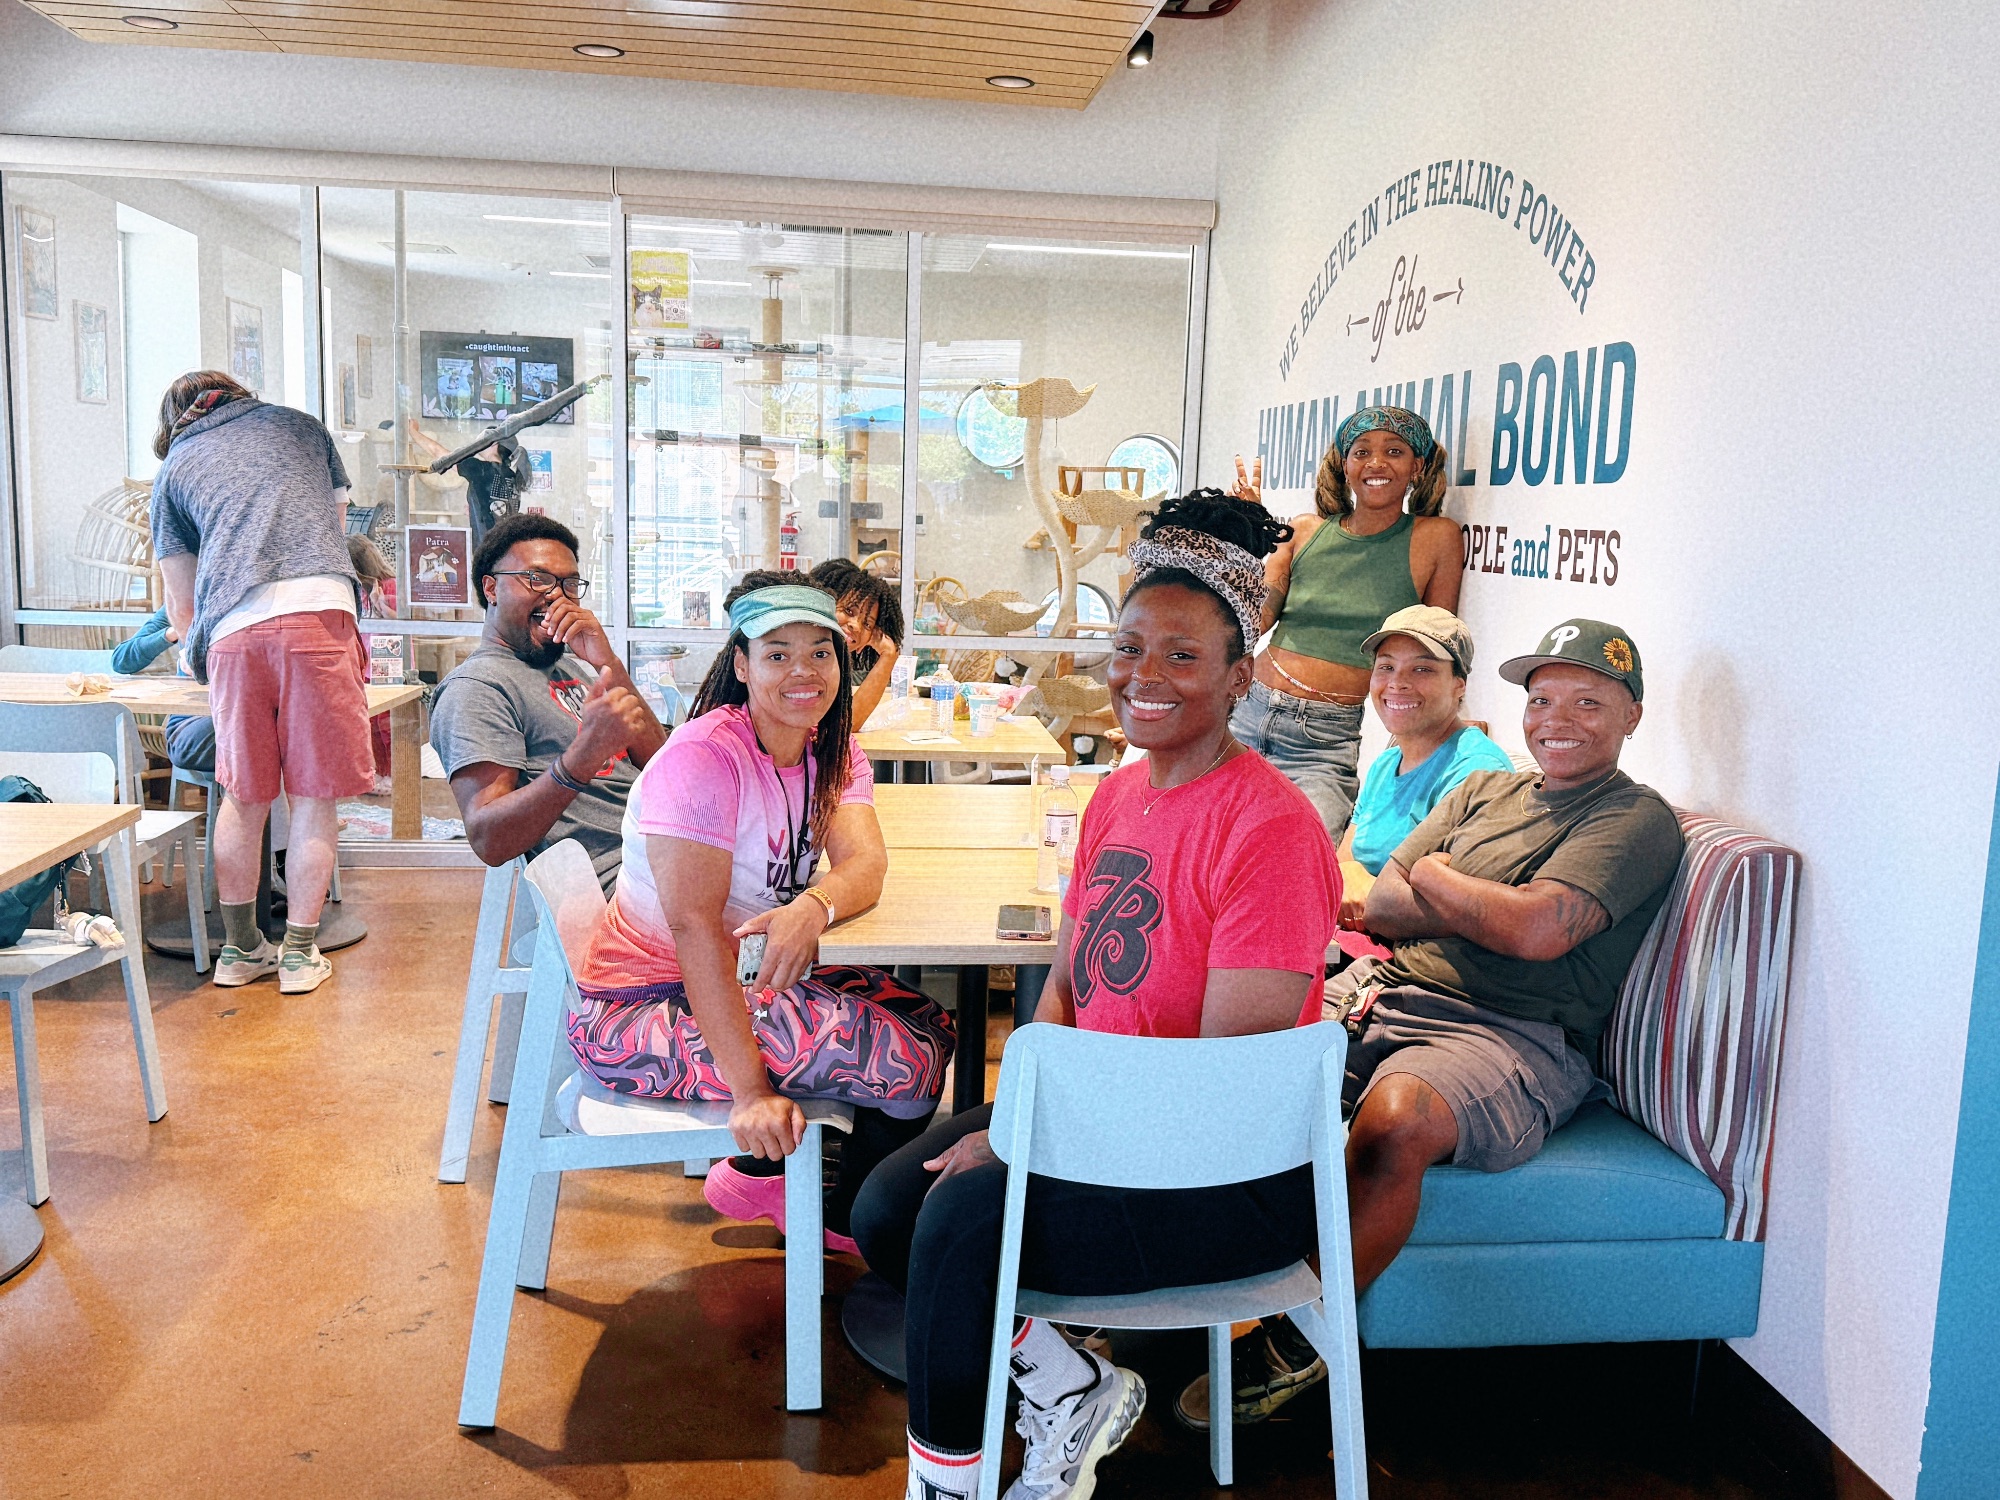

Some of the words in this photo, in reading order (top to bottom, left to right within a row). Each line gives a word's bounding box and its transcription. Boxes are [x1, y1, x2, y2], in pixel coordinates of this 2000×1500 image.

[1279, 323, 1299, 383] WE
[1300, 220, 1357, 338] BELIEVE
[1361, 196, 1380, 248] IN
[1385, 168, 1421, 227] THE
[1424, 158, 1514, 220] HEALING
[1513, 179, 1596, 315] POWER
[1371, 255, 1407, 363] of
[1394, 253, 1427, 337] the
[1489, 341, 1637, 487] BOND
[1511, 524, 1552, 579] and
[1554, 528, 1621, 587] PETS
